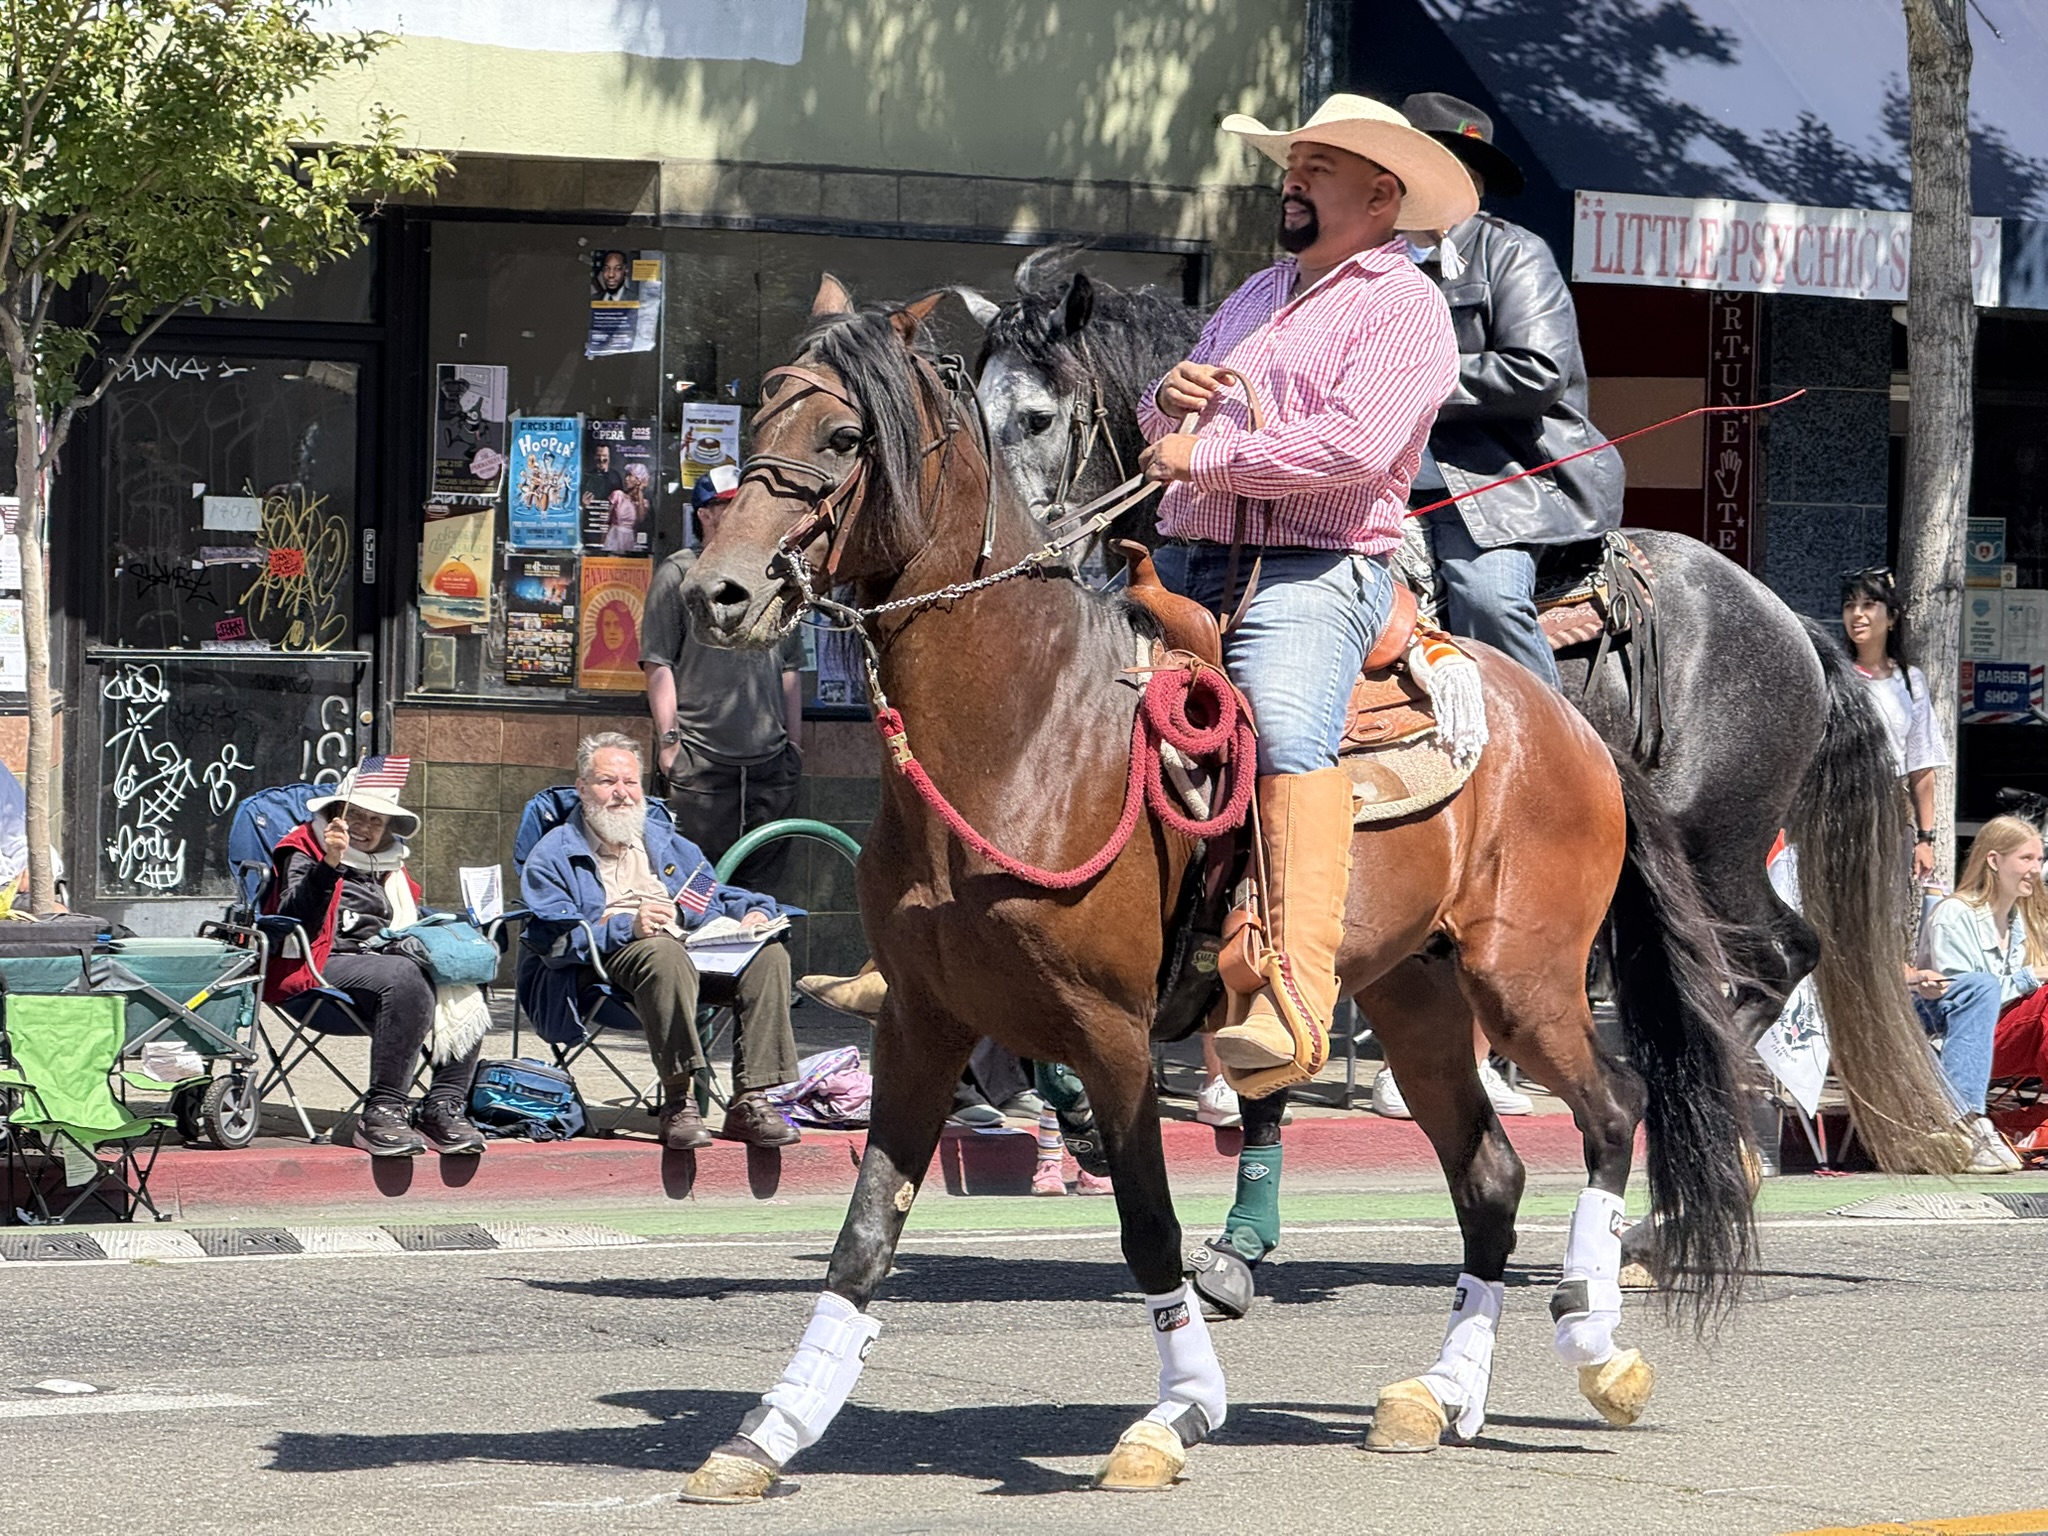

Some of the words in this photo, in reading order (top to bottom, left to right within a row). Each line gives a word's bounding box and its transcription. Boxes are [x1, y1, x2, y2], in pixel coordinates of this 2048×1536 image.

[1591, 210, 1719, 281] LITTLE
[1727, 219, 1880, 291] PSYCHIC
[520, 421, 547, 431] CIRCUS
[549, 421, 573, 431] BELLA
[592, 430, 626, 440] OPERA
[365, 533, 374, 570] PULL
[1976, 669, 2028, 685] BARBER
[1984, 690, 2019, 704] SHOP
